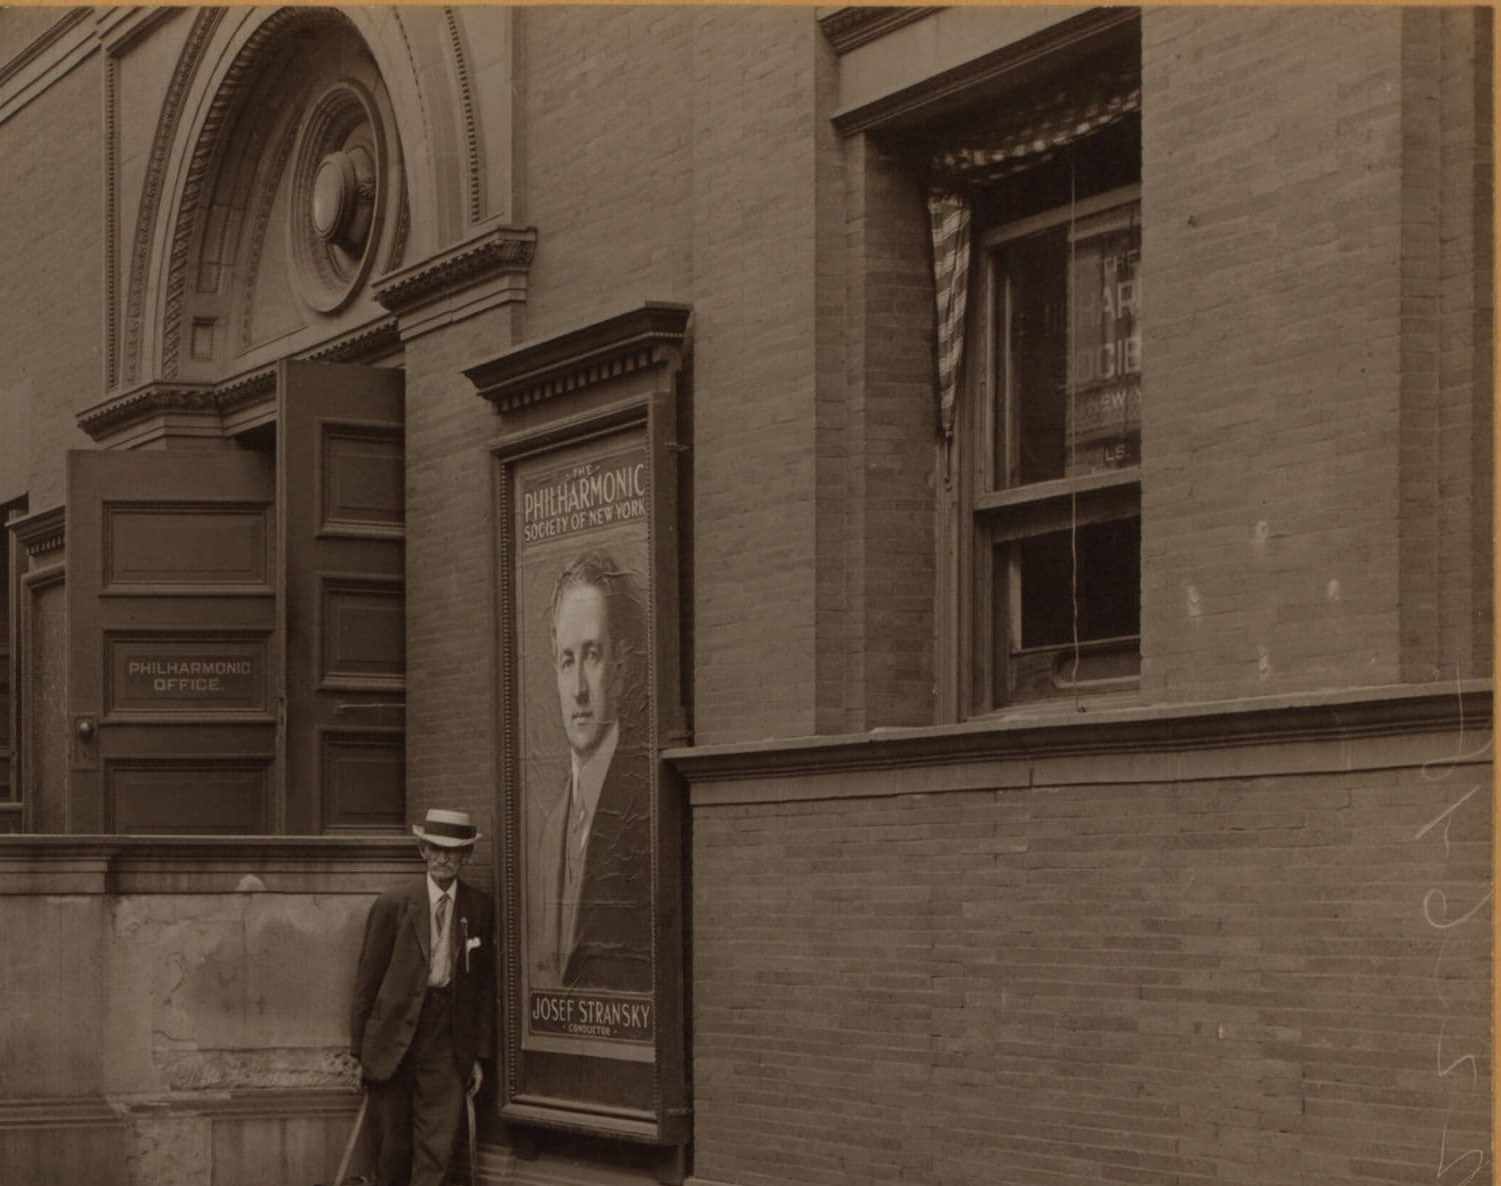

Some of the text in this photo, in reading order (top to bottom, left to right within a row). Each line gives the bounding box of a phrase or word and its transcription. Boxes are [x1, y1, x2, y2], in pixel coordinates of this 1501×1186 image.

[573, 464, 593, 478] THE
[524, 463, 646, 522] PHILHARMONIC
[524, 497, 646, 542] SOCIETY OF NEW YORK
[128, 661, 251, 675] PHILHARMONIC
[532, 997, 651, 1028] JOSEF STRANSKY
